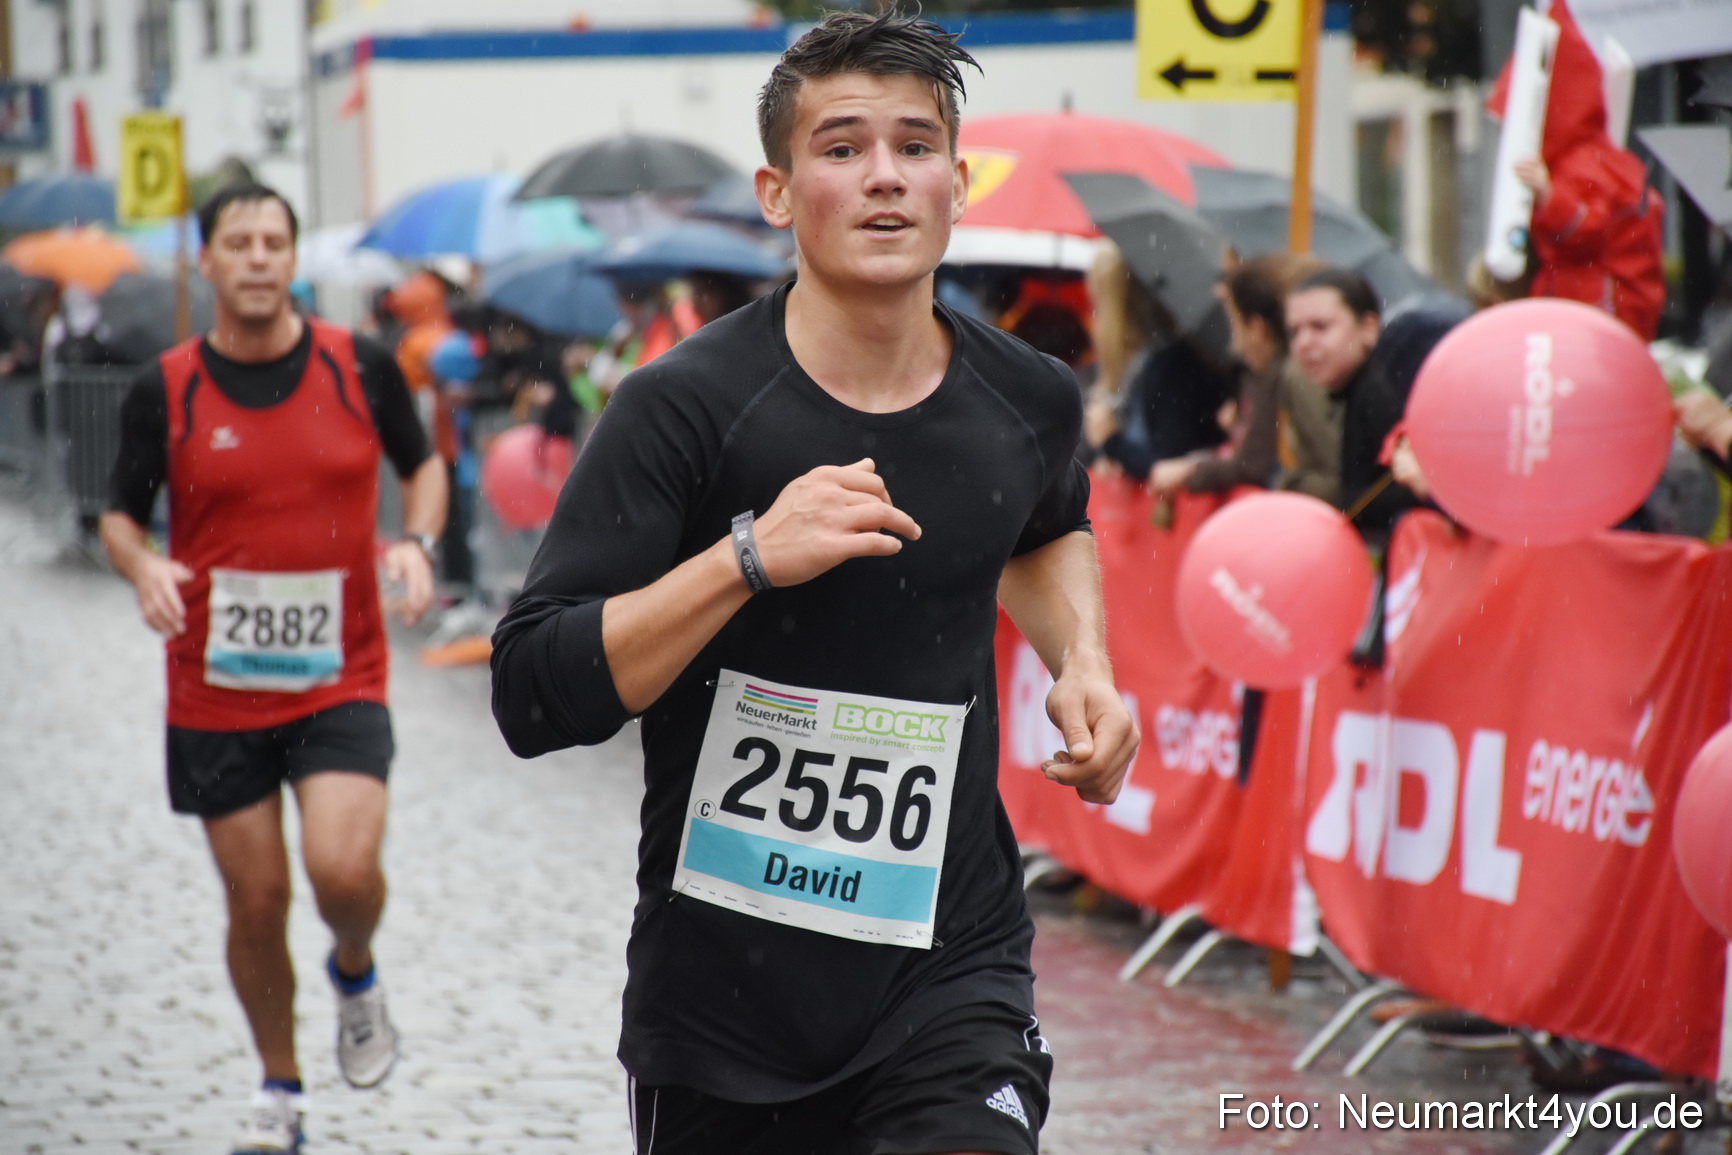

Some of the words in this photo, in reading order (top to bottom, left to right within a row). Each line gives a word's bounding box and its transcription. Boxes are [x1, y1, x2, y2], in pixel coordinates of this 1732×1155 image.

[133, 146, 170, 198] D
[226, 603, 329, 647] 2882
[735, 700, 818, 731] NeuerMarkt
[833, 702, 949, 742] BOCK
[830, 731, 868, 744] inspired
[869, 736, 881, 747] by
[882, 739, 911, 750] smart
[911, 743, 946, 753] concepts
[700, 801, 711, 818] C
[719, 736, 937, 852] 2556
[763, 851, 862, 903] David
